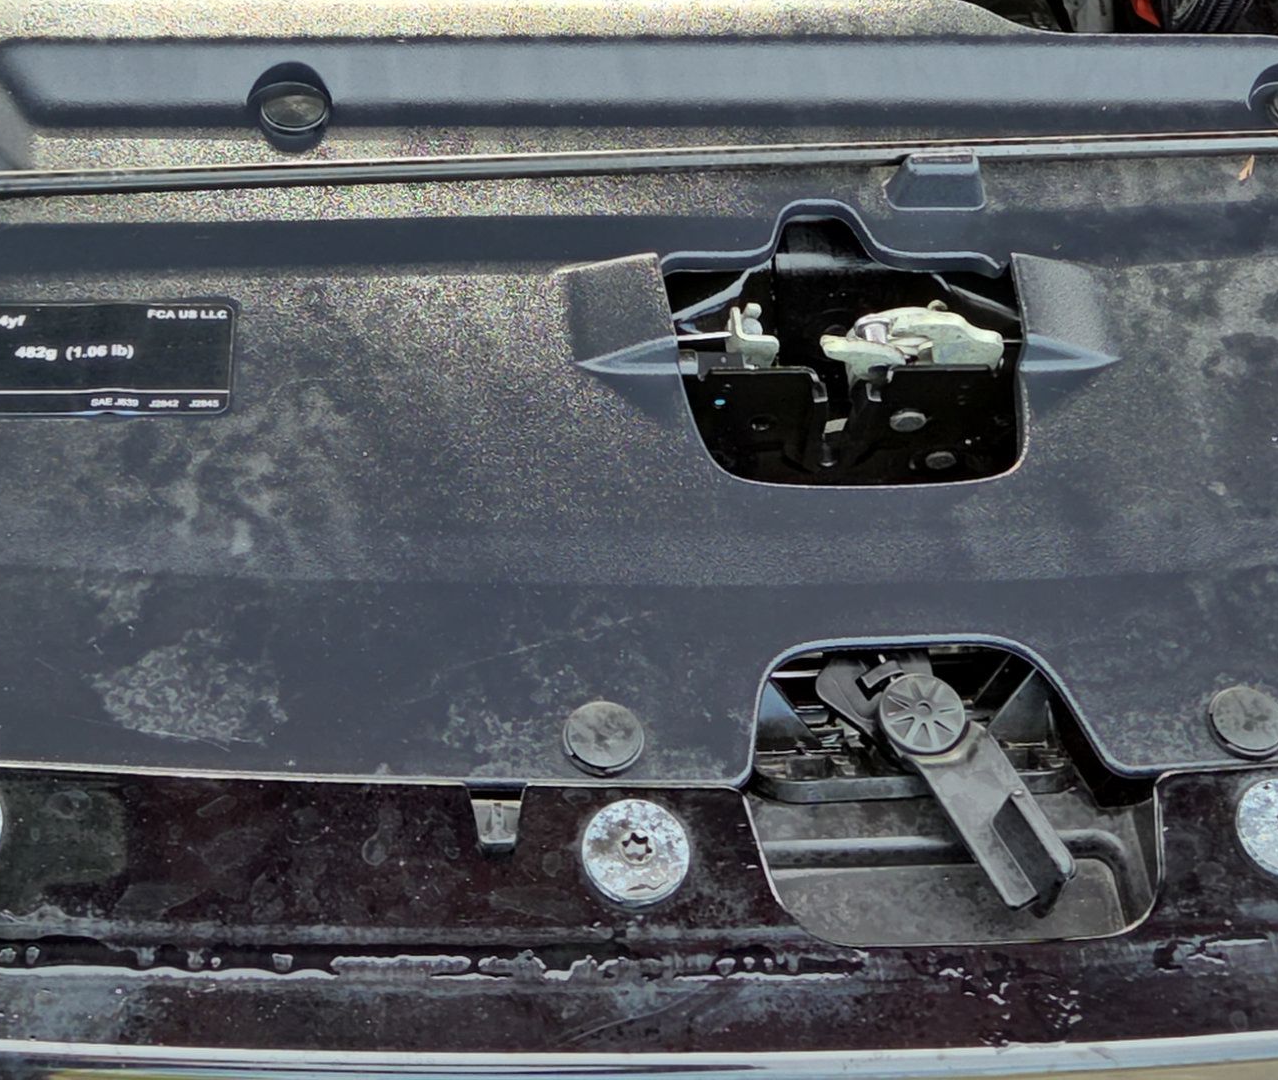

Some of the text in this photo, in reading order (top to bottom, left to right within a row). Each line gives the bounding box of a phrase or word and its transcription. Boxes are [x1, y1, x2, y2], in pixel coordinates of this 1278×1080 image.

[146, 309, 228, 320] FCA US LLC
[110, 344, 134, 360] lb)
[90, 397, 112, 407] SAE
